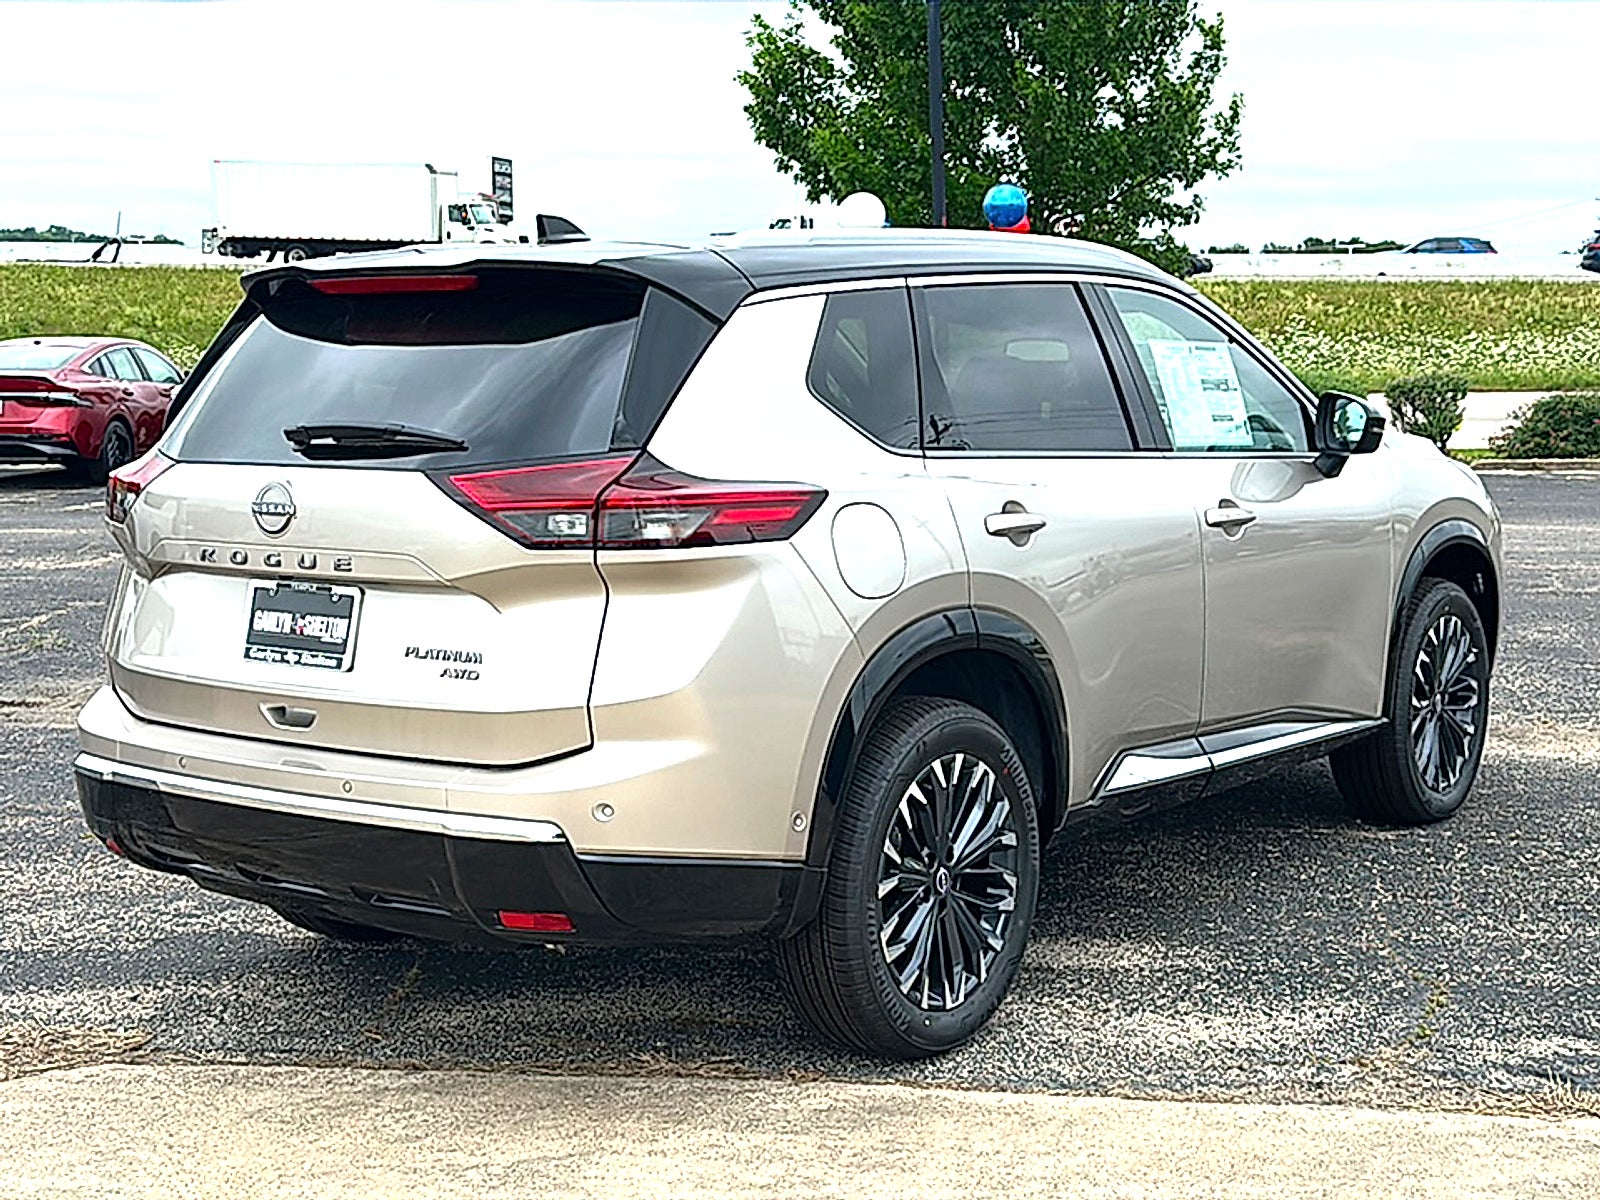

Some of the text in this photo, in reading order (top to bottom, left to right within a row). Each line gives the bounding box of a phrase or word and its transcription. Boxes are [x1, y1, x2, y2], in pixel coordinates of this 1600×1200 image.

[252, 502, 296, 515] NISSAN
[199, 548, 353, 573] ROGUE
[404, 646, 482, 664] PLATINUM
[440, 667, 480, 680] AWD
